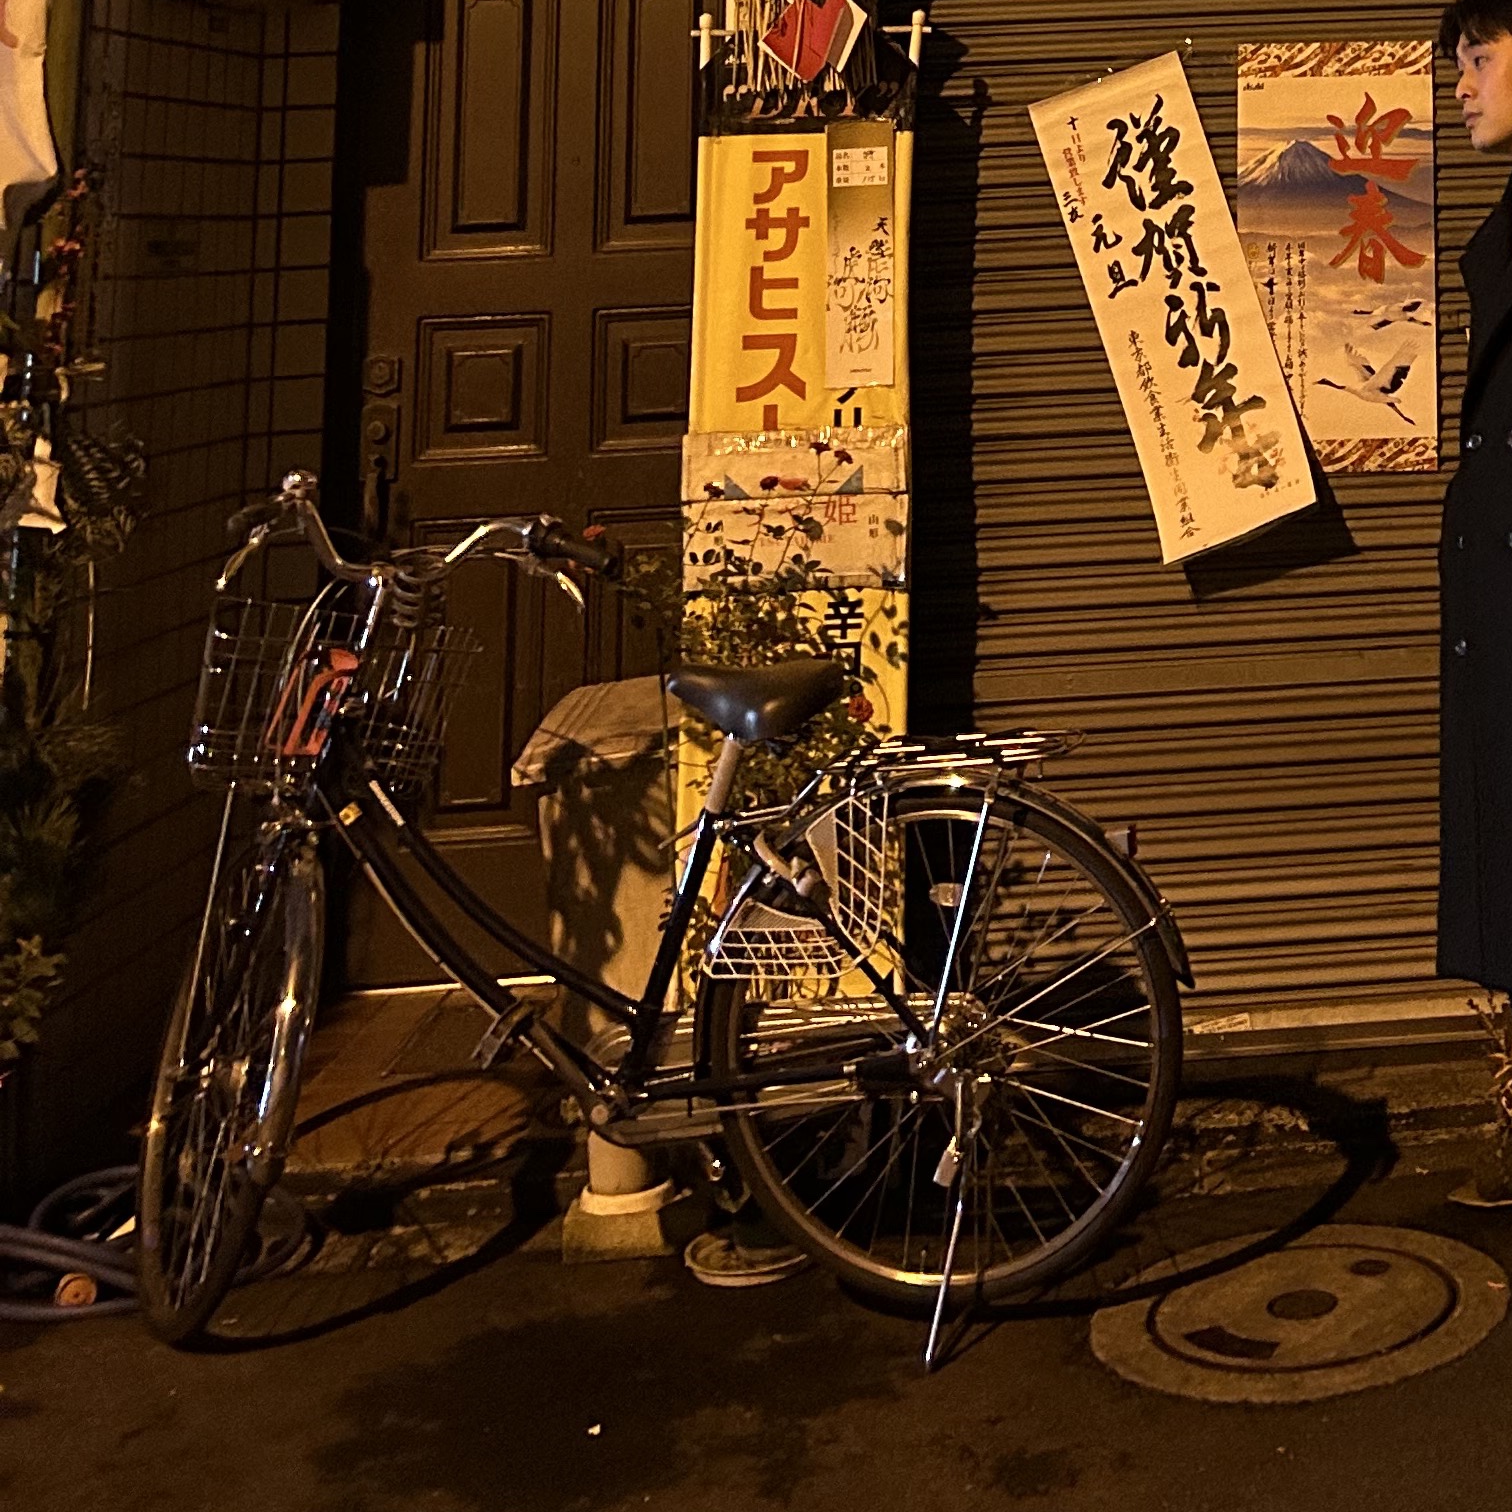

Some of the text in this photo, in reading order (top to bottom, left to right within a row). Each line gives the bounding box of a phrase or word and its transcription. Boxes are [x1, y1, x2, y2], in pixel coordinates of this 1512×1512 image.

[1090, 213, 1139, 299] 元旦
[1102, 93, 1267, 454] 謹賀新年
[1326, 91, 1427, 283] 迎春
